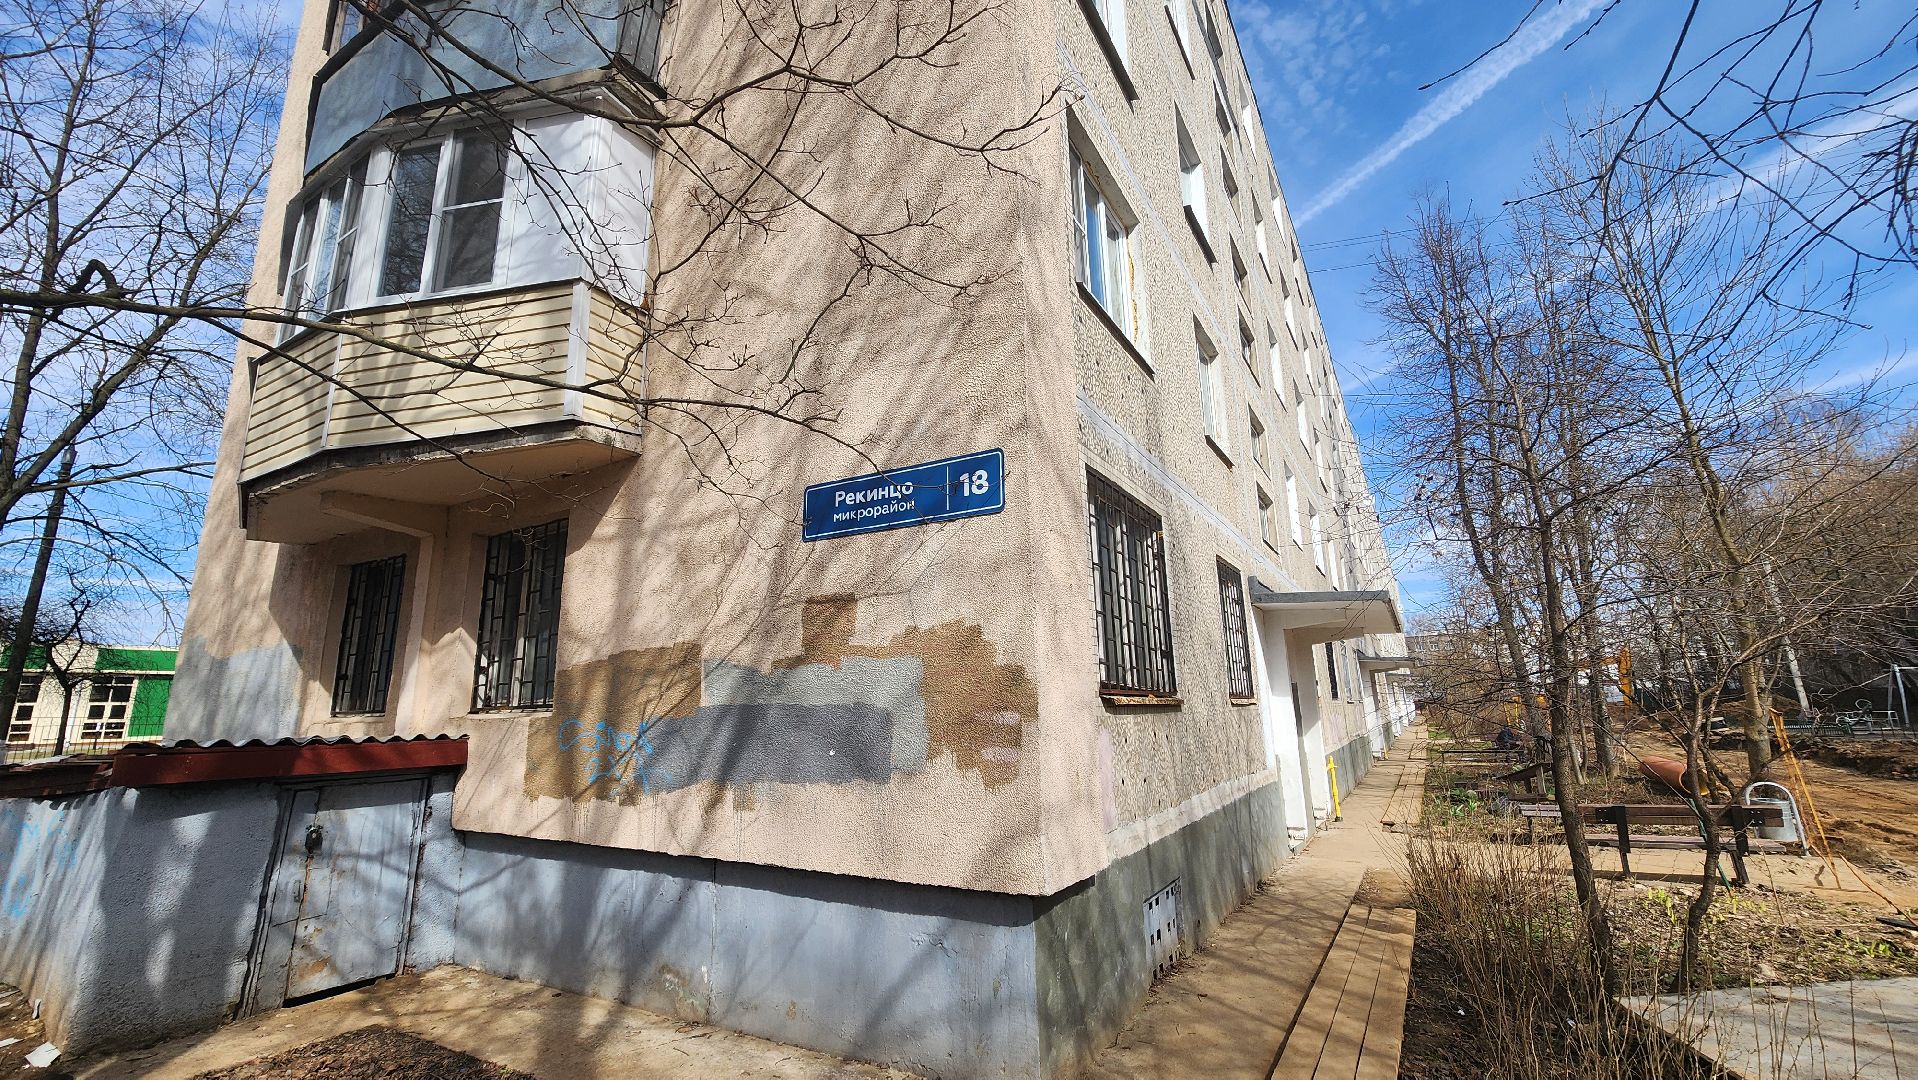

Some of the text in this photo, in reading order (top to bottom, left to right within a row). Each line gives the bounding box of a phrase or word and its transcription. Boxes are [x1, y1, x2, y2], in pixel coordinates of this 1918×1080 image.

[835, 482, 914, 507] Рекинцо
[959, 470, 989, 496] 18
[833, 500, 915, 522] микрорайон
